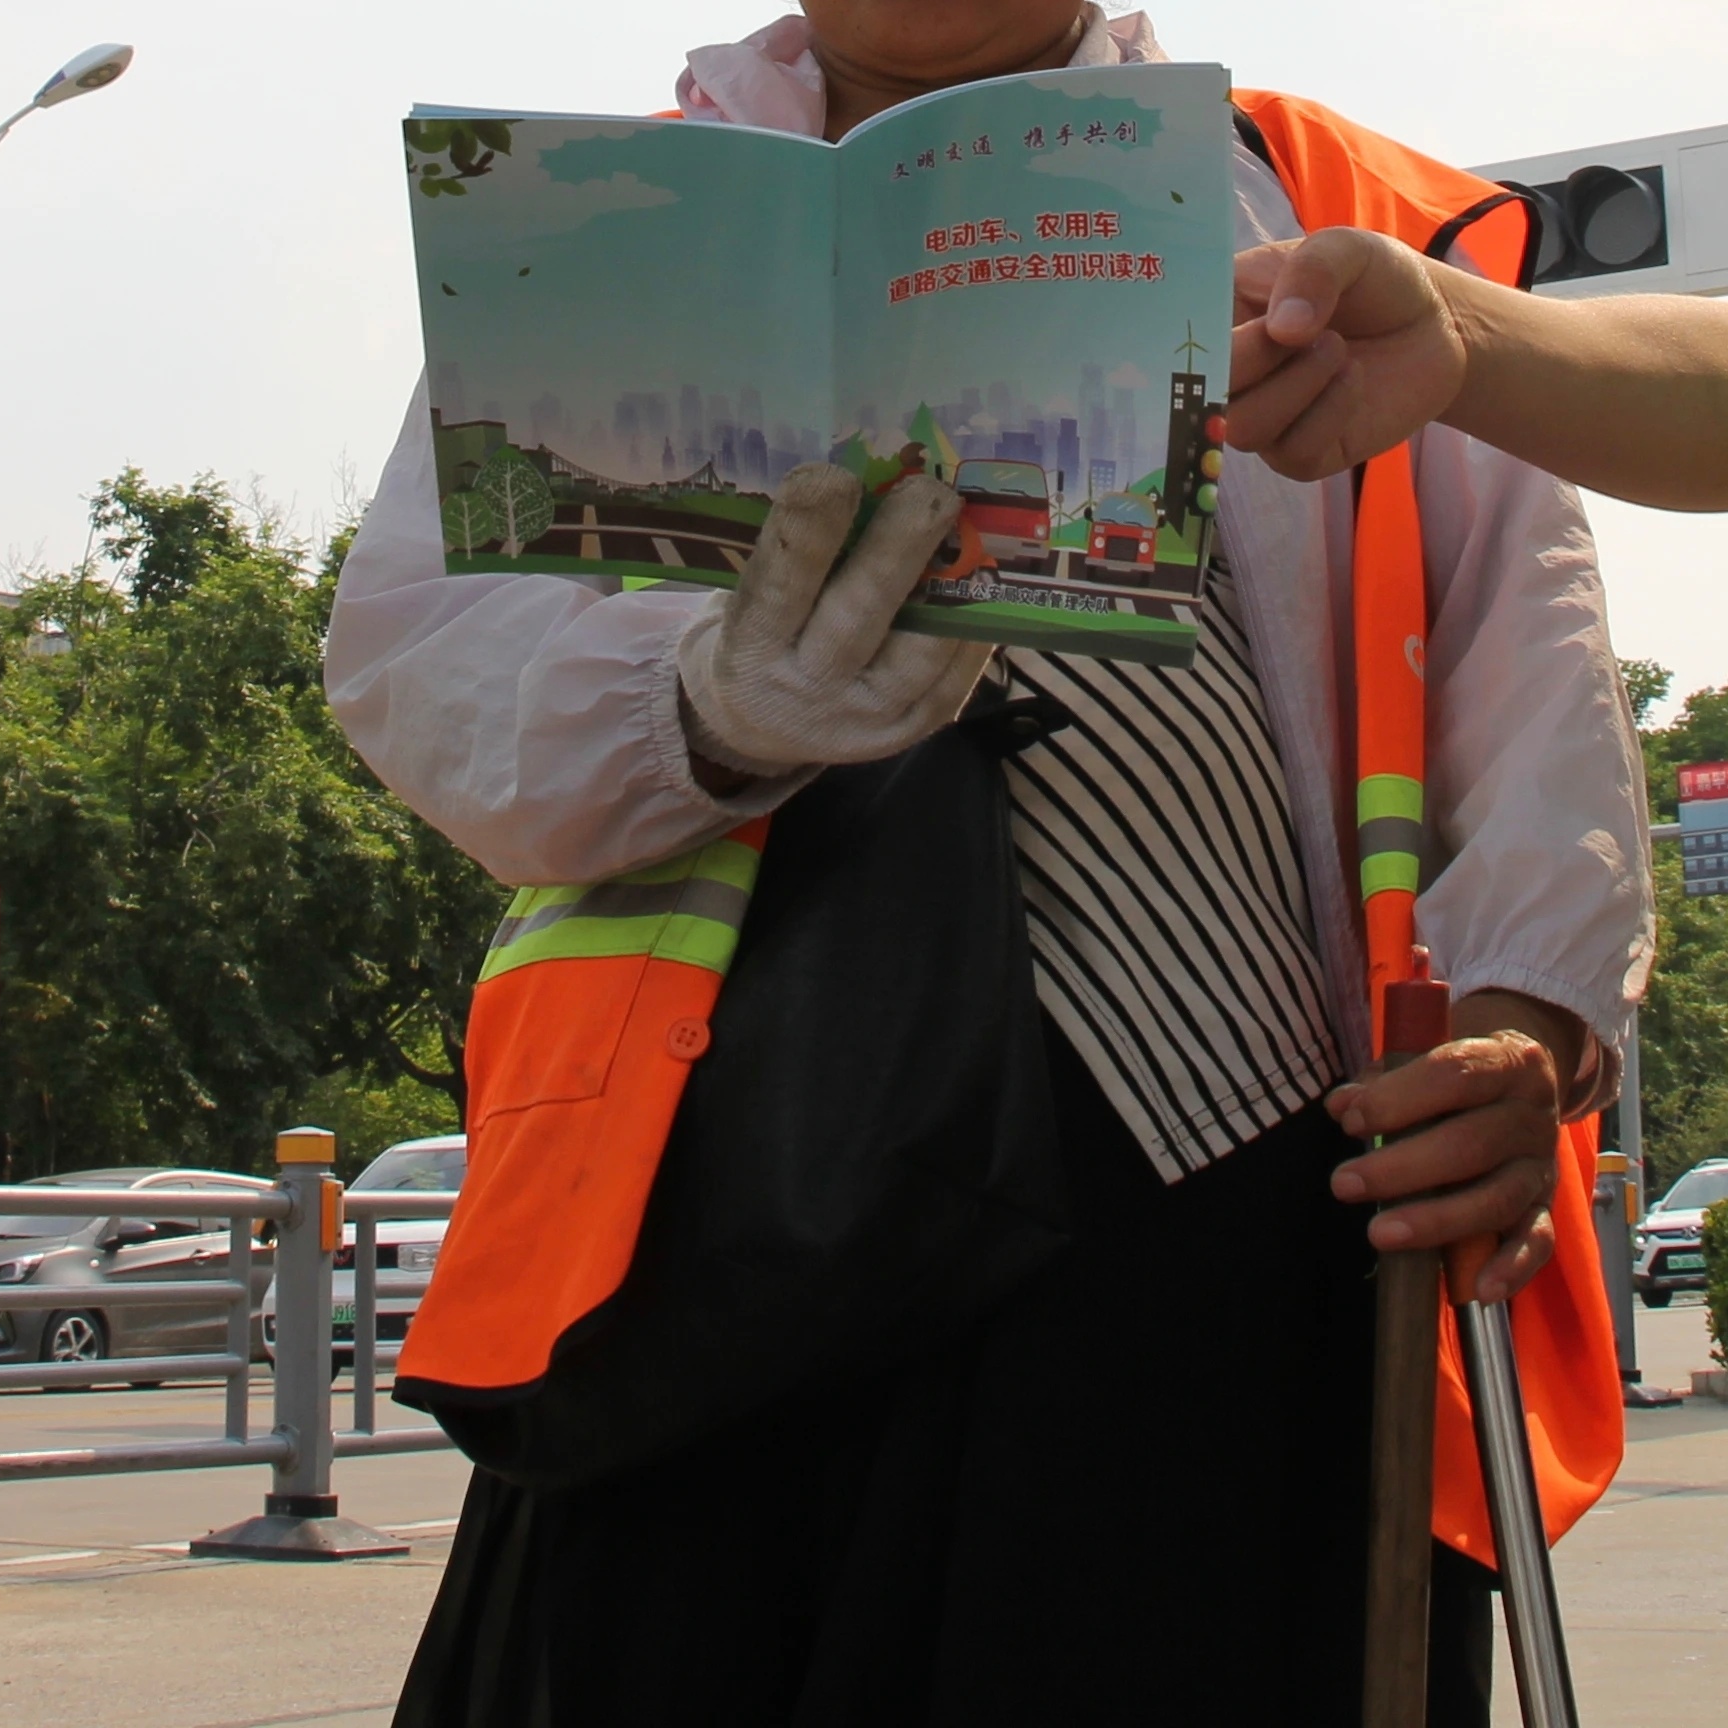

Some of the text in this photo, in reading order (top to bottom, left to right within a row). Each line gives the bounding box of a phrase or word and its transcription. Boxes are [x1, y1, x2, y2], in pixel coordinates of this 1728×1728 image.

[925, 210, 1121, 254] 电动车、农用车
[887, 252, 1164, 306] 道路交通安全知识读本
